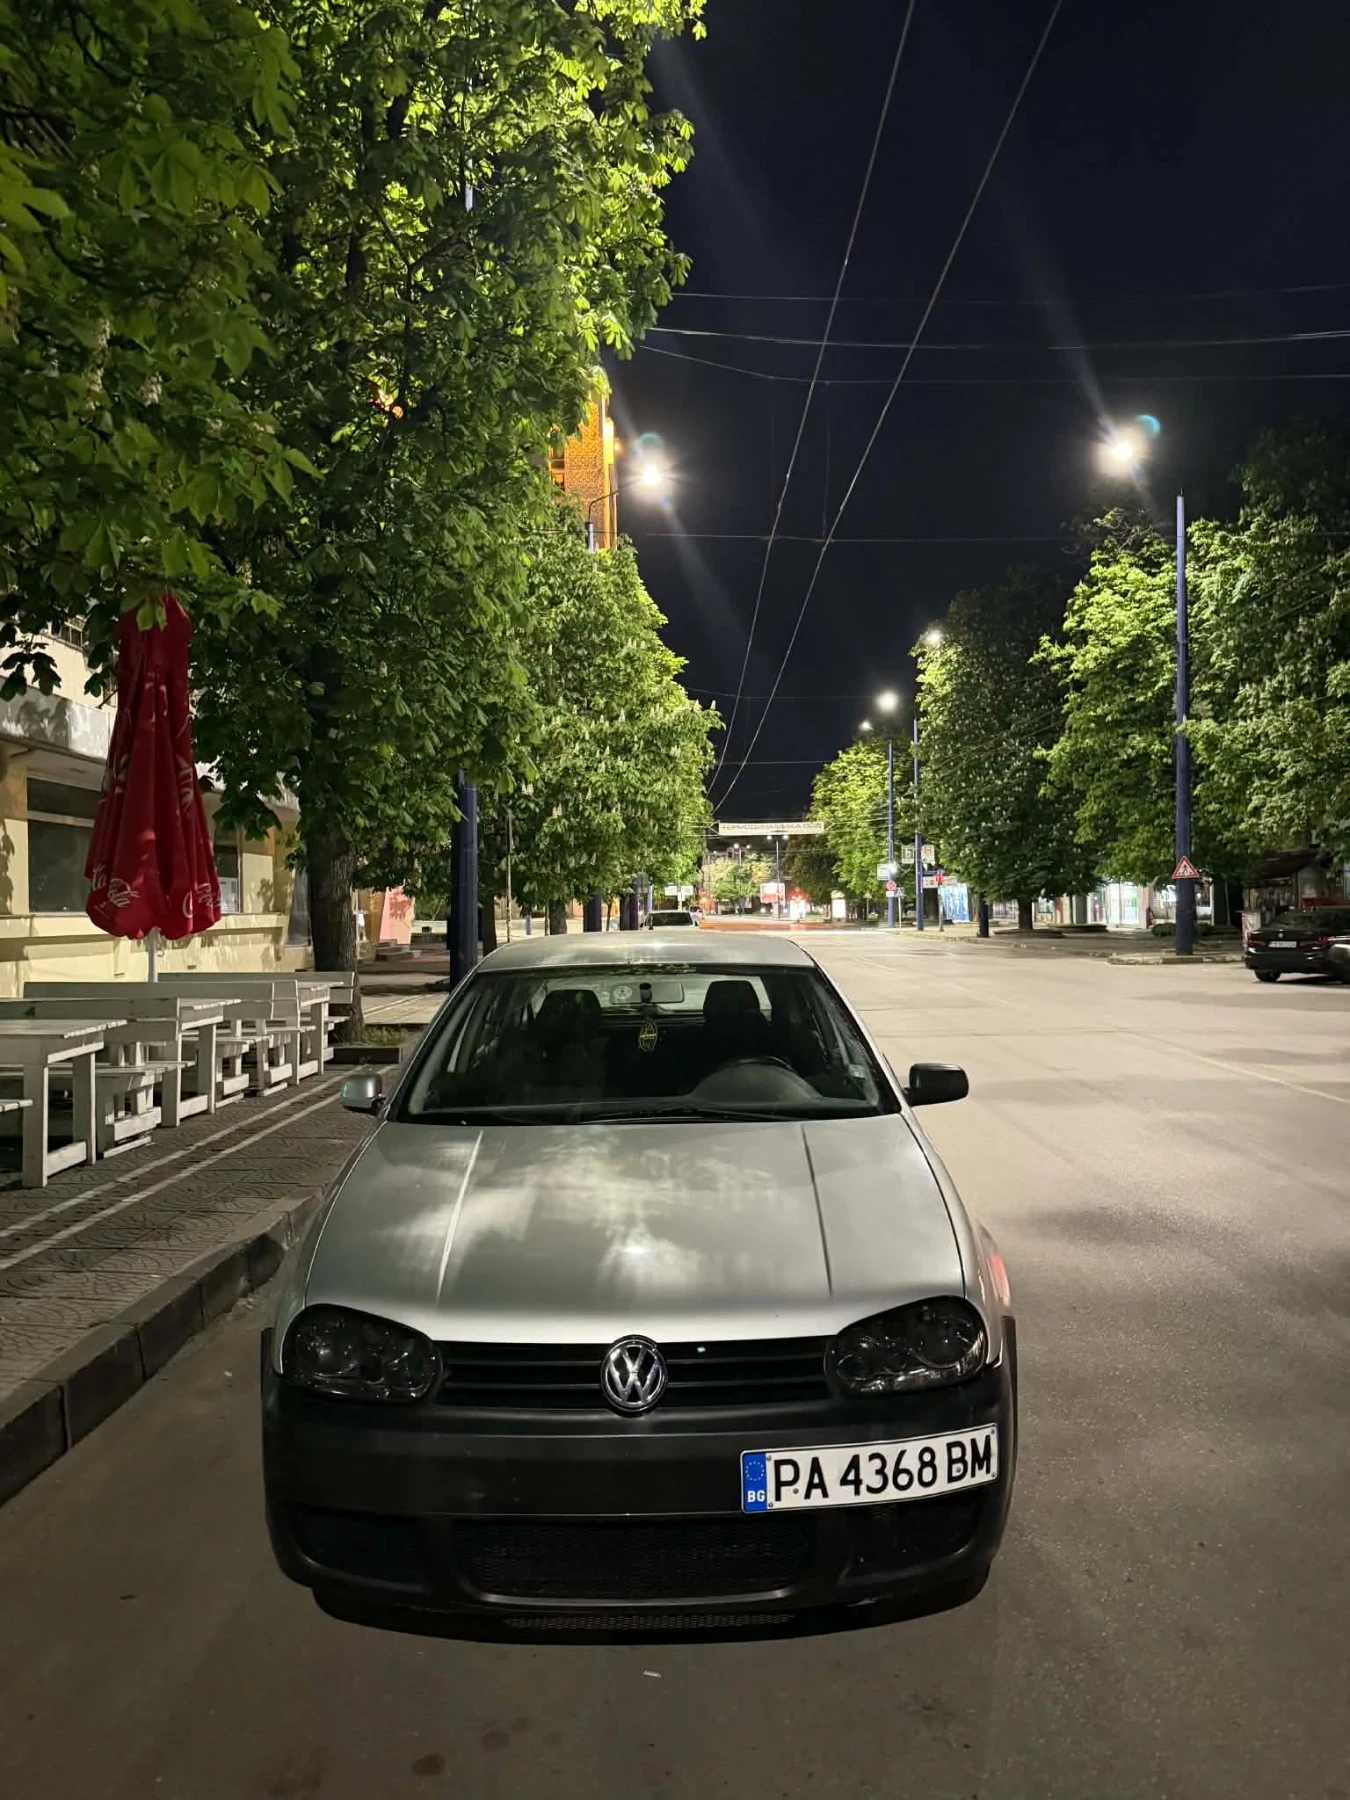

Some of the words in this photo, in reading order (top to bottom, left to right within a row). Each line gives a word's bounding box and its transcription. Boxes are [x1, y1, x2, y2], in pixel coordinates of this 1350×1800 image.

[605, 1343, 662, 1405] VW
[747, 1490, 765, 1503] BG
[774, 1456, 829, 1502] PA
[839, 1446, 938, 1497] 4368
[946, 1435, 992, 1484] BM
